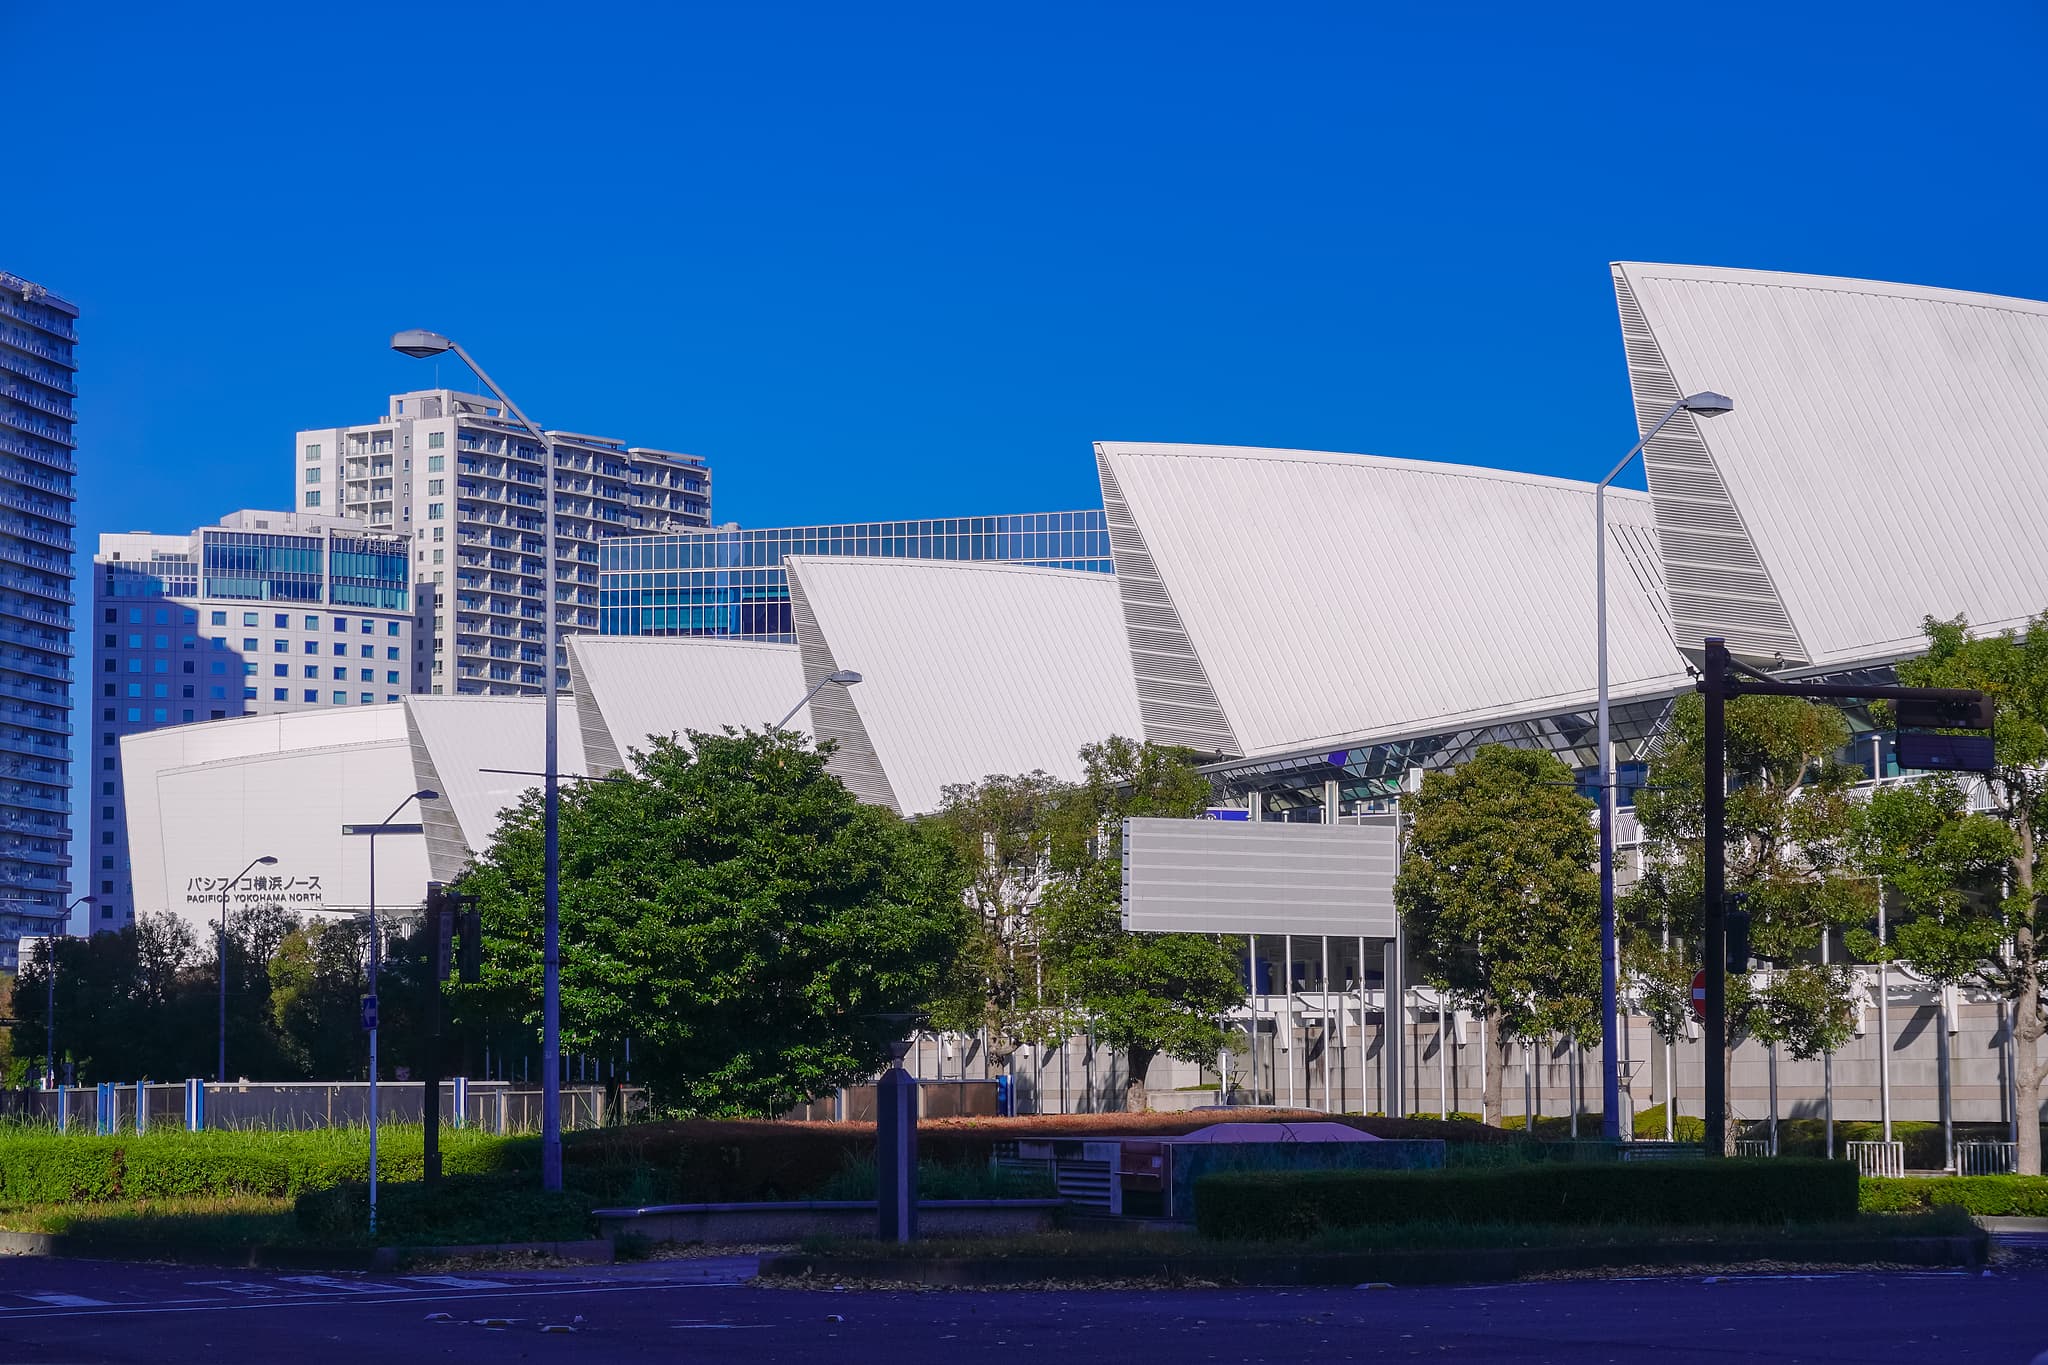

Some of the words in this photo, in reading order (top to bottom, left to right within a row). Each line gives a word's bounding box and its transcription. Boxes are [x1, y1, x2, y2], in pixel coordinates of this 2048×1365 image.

[187, 876, 322, 891] パシフィコ横浜ノース
[186, 894, 230, 903] PACIFICO
[234, 894, 287, 903] YOKOHAMA
[289, 893, 322, 903] NORTH
